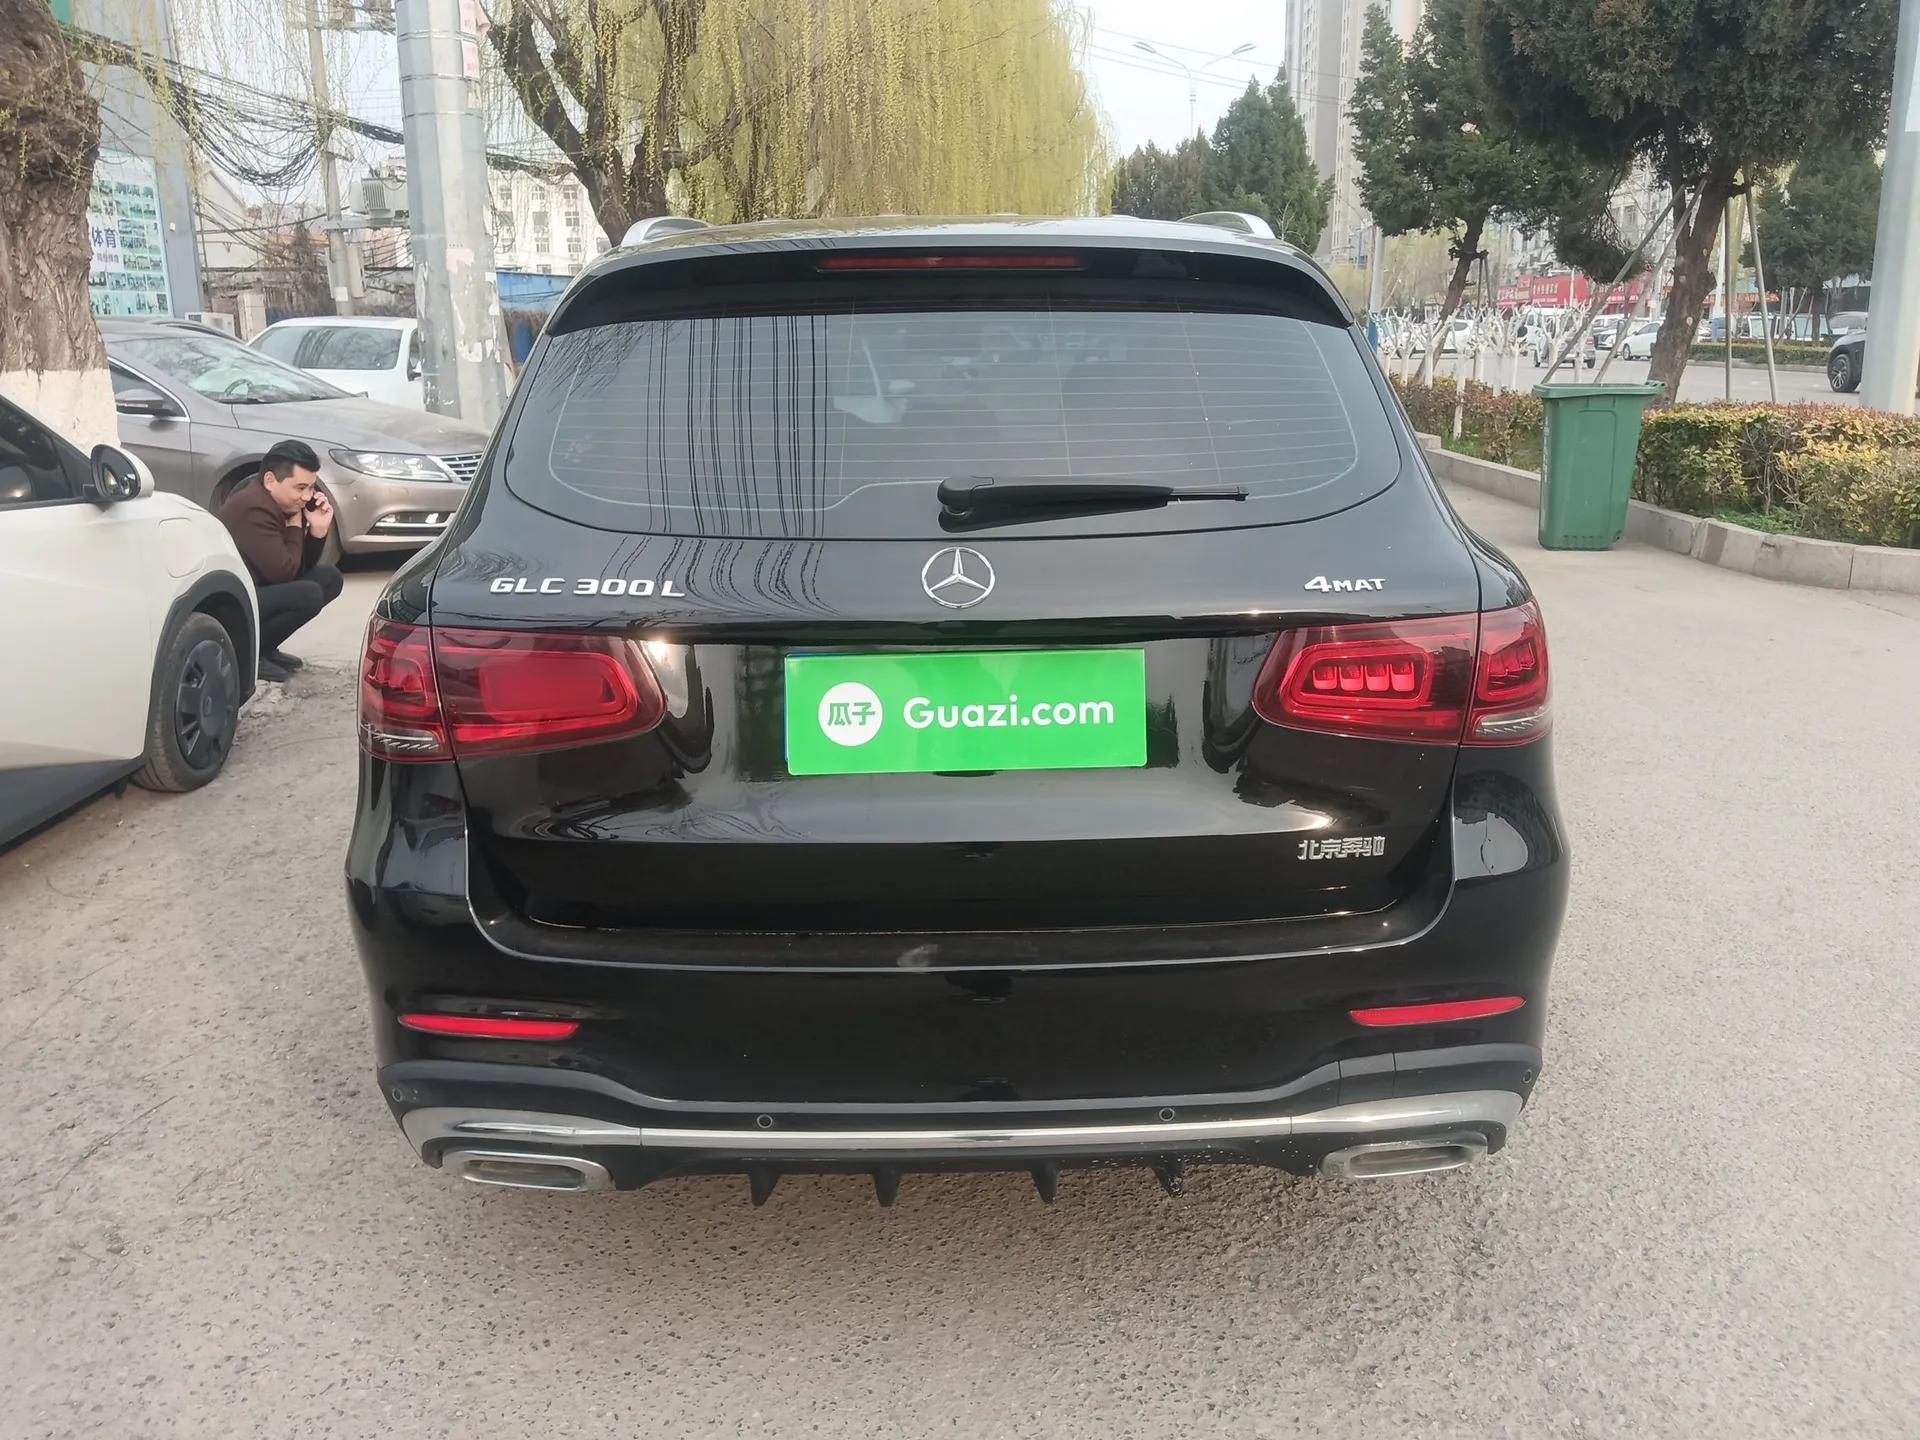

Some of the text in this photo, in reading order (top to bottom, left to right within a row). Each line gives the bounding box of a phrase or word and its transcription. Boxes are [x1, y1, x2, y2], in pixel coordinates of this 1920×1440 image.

[91, 226, 117, 249] 体育
[490, 577, 565, 594] GLC
[1304, 576, 1385, 593] 4MAT
[827, 702, 876, 727] 瓜子
[903, 694, 1115, 730] Guazi.com
[1297, 835, 1386, 861] 北京奔驰
